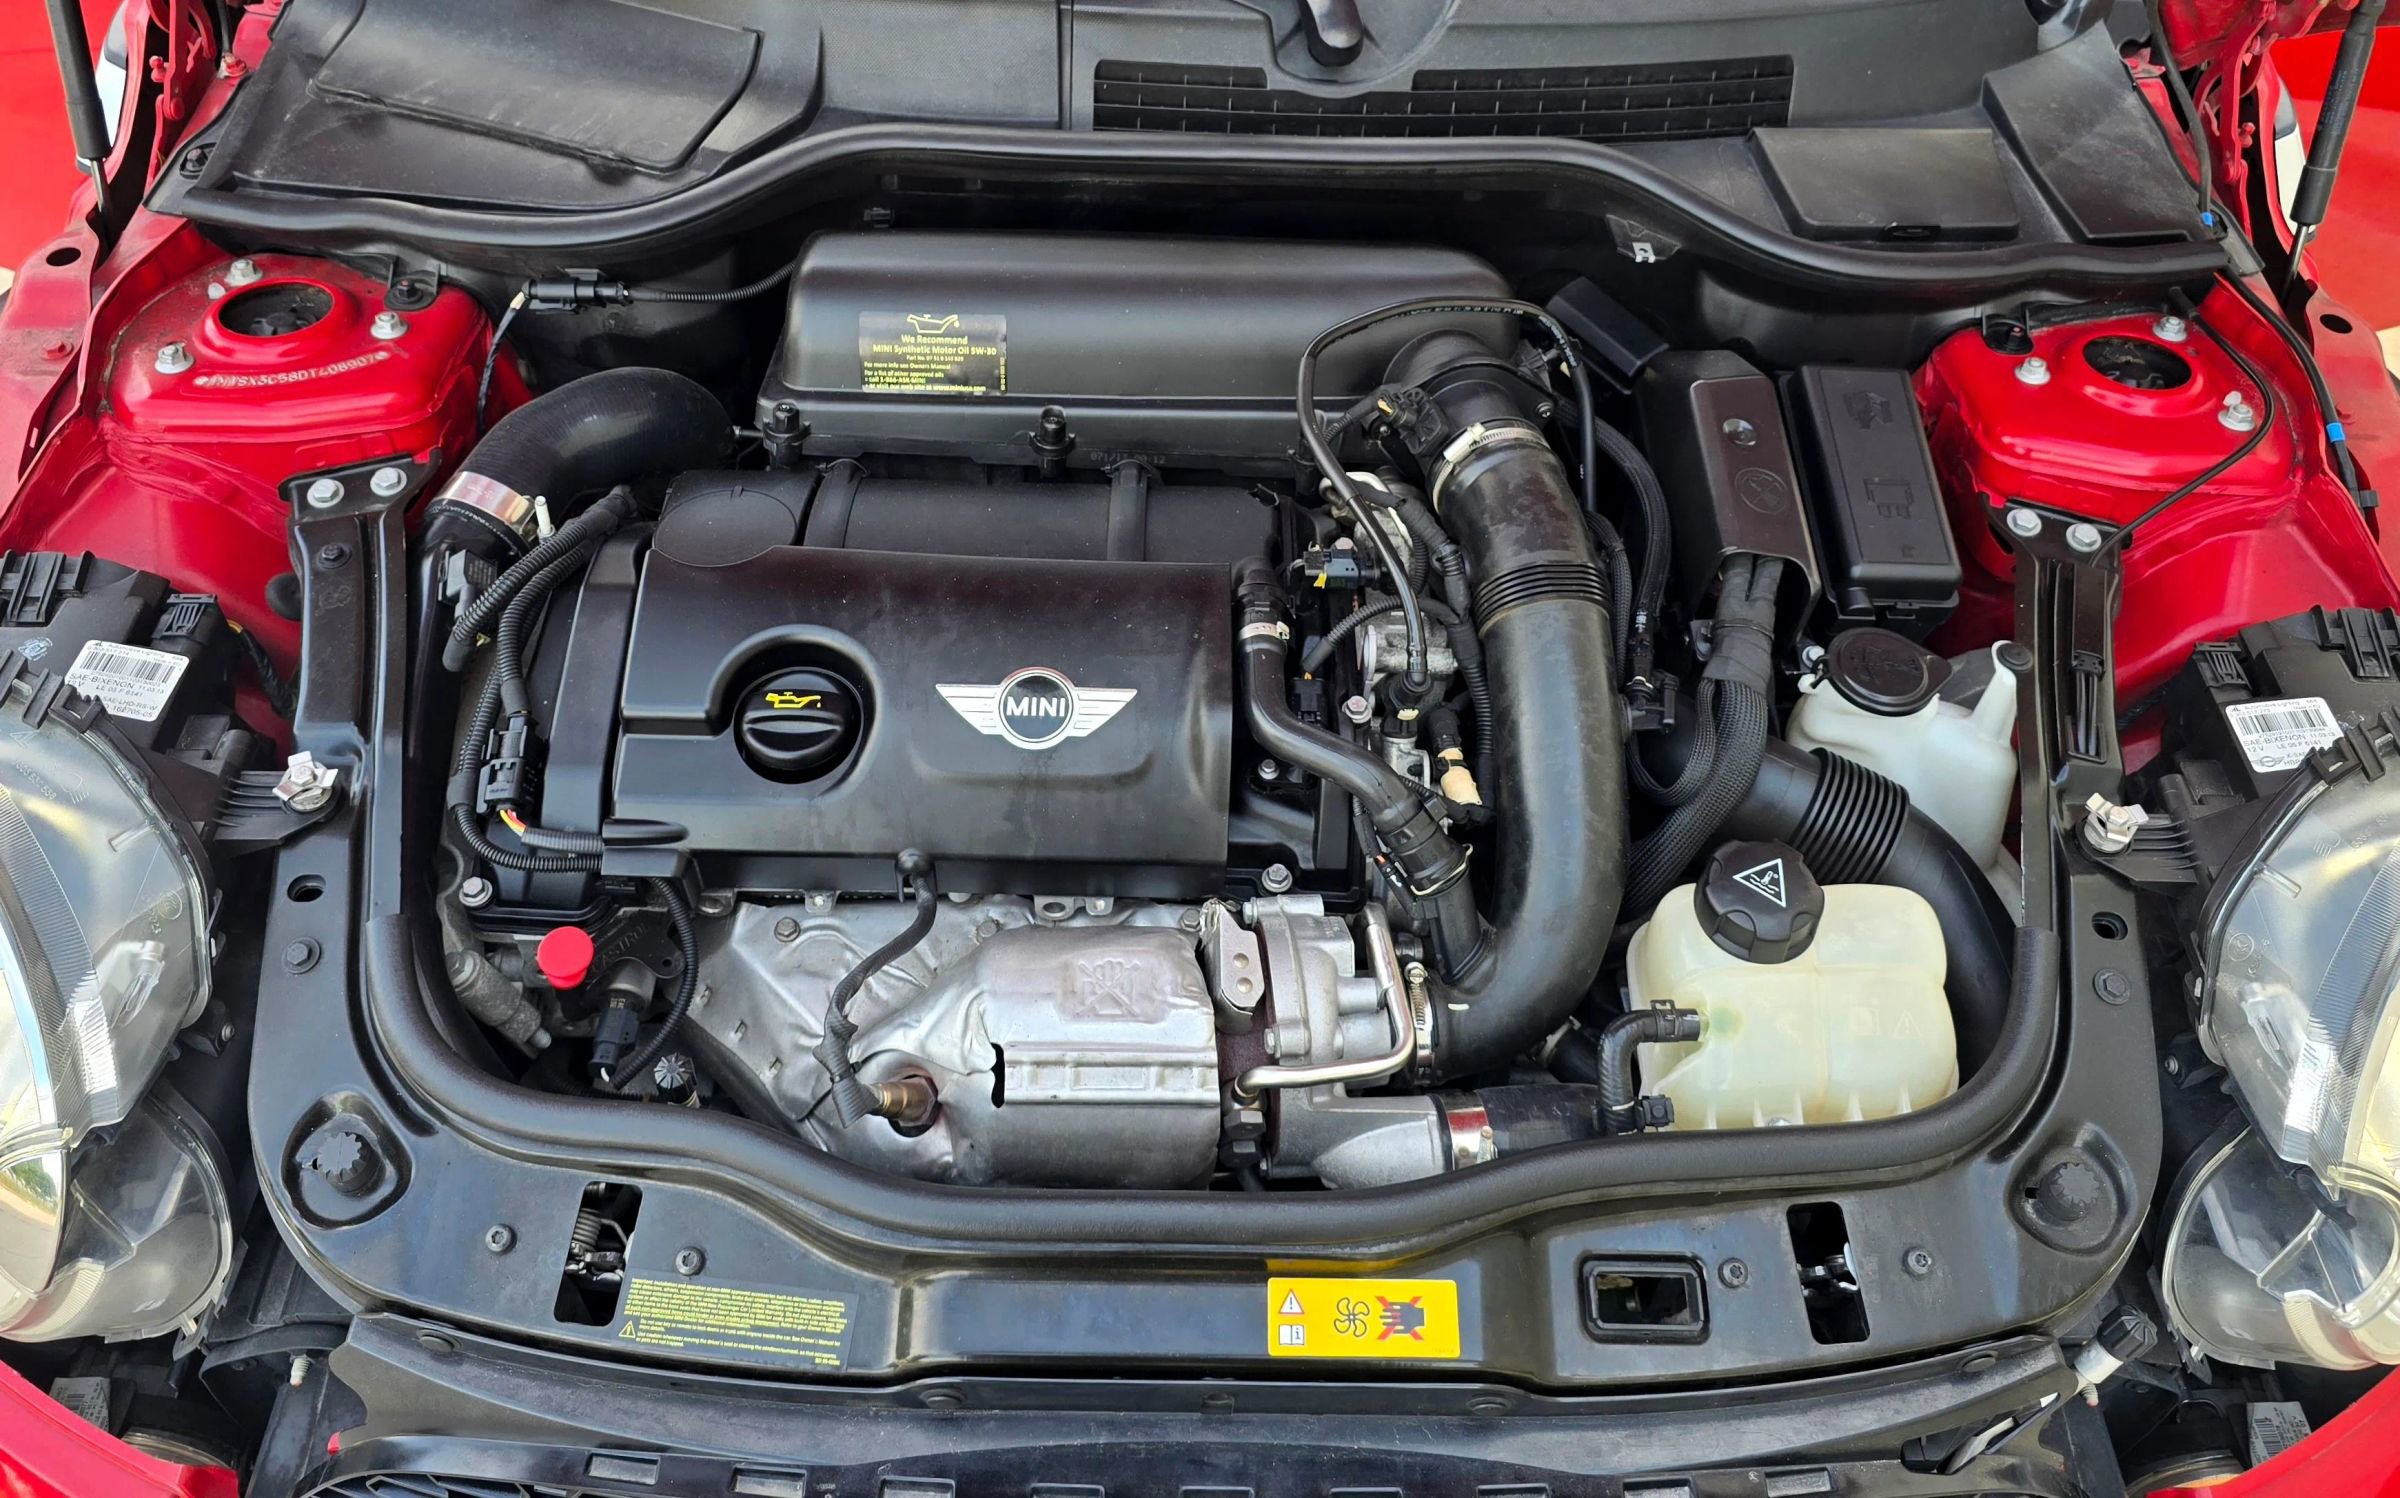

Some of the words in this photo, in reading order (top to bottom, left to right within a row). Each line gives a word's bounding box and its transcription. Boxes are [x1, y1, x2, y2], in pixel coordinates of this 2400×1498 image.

[901, 335, 915, 344] We
[917, 336, 968, 345] Recommend
[872, 344, 892, 352] MINI
[894, 345, 930, 354] Synthetic
[932, 346, 956, 354] Motor
[958, 346, 969, 354] Oil
[970, 347, 996, 355] 5W-30
[1006, 696, 1066, 717] MINI
